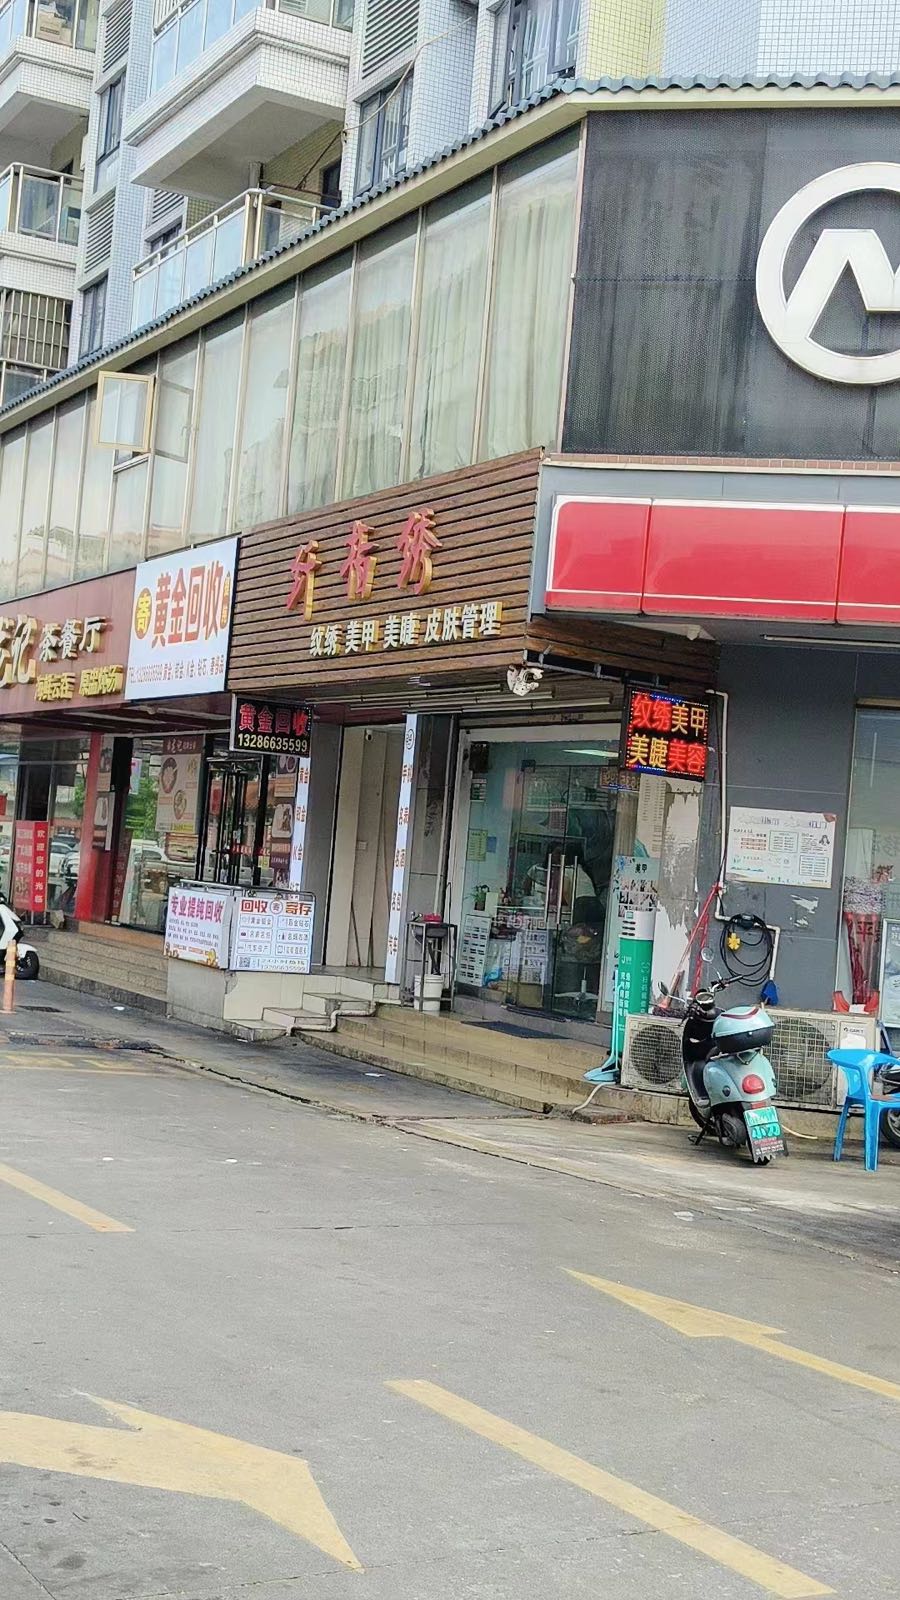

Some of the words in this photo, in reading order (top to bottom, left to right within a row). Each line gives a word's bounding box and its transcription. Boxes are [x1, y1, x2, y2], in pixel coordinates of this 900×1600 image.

[151, 561, 224, 647] 黄金回收
[39, 616, 108, 662] 茶餐厅
[310, 623, 343, 656] 纹绣
[345, 619, 380, 653] 美甲
[383, 612, 421, 648] 美睫
[425, 601, 503, 643] 皮肤管理
[239, 703, 309, 737] 黄金回收
[633, 694, 706, 737] 纹绣美甲
[238, 732, 308, 753] 13286635599
[629, 733, 706, 773] 美睫美容
[170, 894, 225, 923] 专业提纯回收
[241, 899, 268, 913] 回收
[286, 902, 312, 915] 寄存
